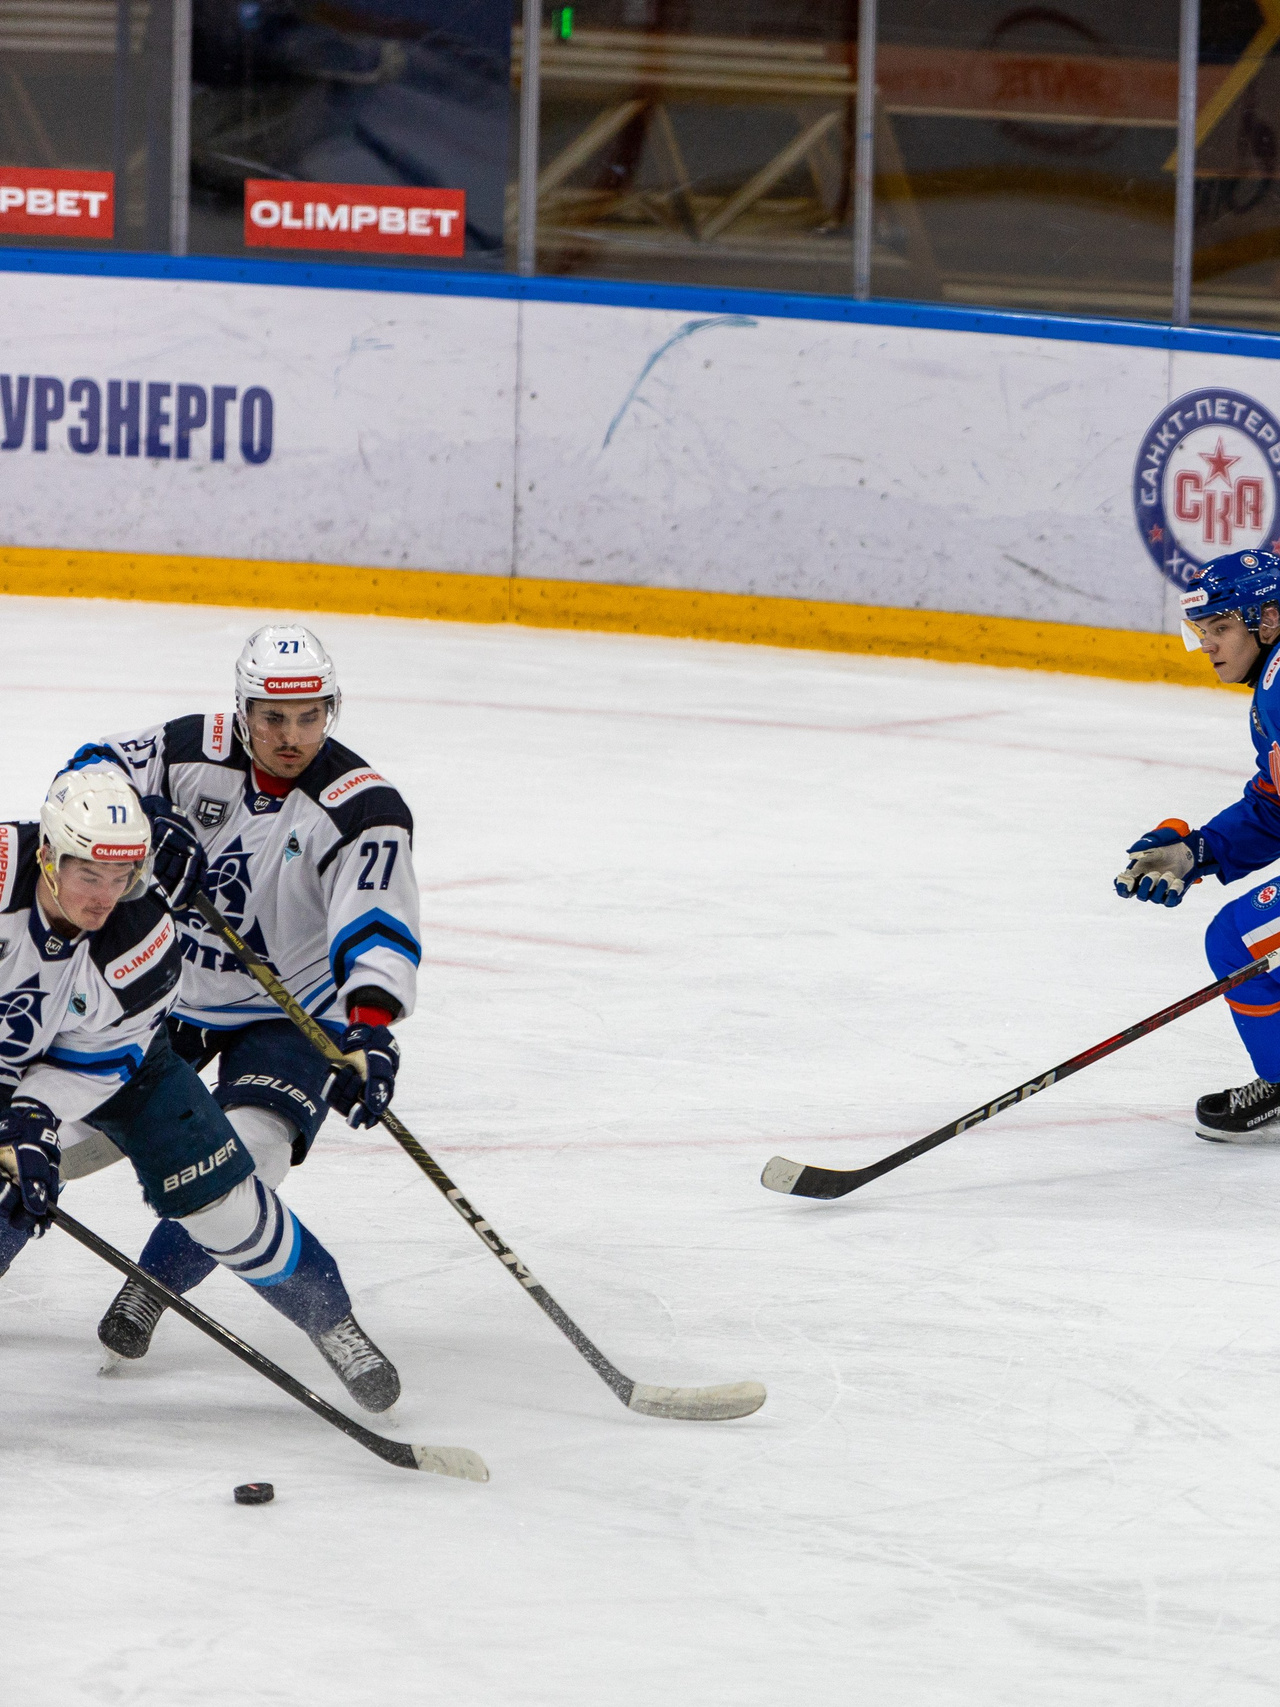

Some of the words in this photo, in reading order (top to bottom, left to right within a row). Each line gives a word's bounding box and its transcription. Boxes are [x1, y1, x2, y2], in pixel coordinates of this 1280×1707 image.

[250, 200, 459, 237] OLIMPBET
[0, 373, 274, 465] УРЭНЕРГО
[1173, 468, 1263, 545] СКА
[277, 640, 299, 654] 27
[267, 680, 320, 689] OLIMPBET
[95, 847, 145, 857] OLIMPBET
[357, 840, 399, 890] 27
[113, 922, 171, 980] OLIMPBET
[446, 1188, 541, 1290] CCM
